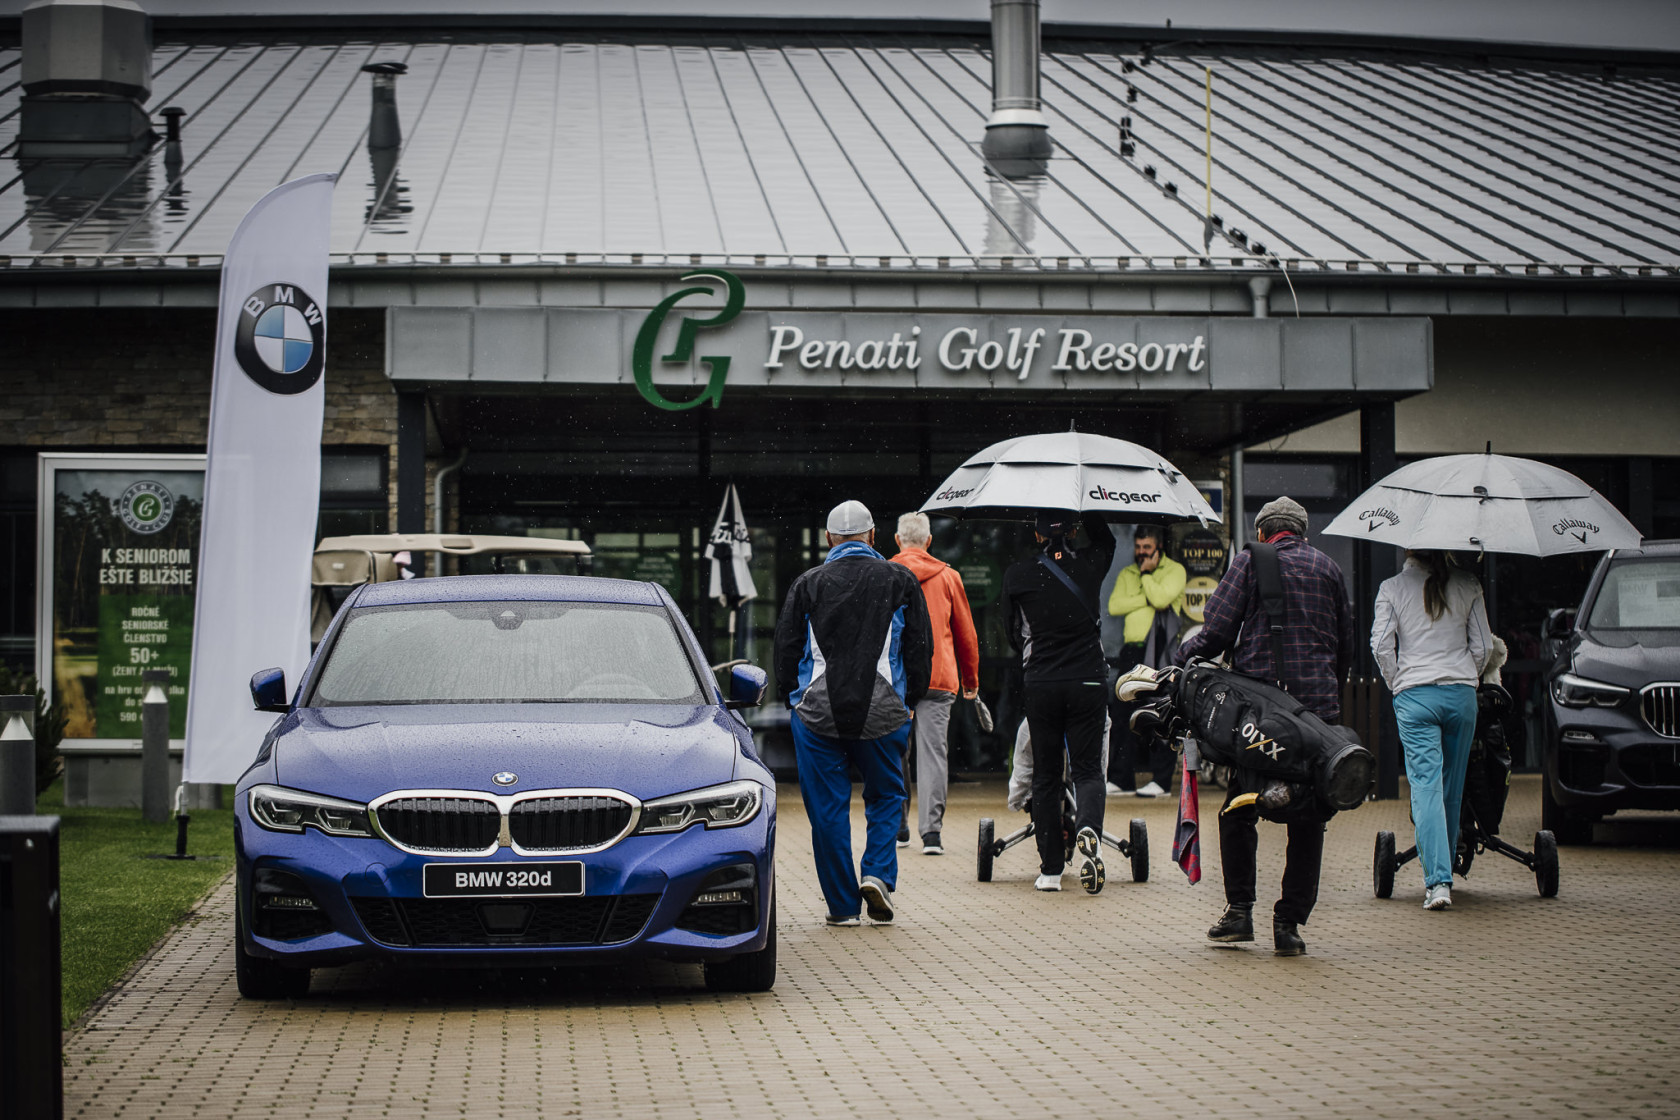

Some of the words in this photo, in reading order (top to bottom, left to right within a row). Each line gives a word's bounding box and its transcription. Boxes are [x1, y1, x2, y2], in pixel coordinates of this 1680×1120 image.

[243, 285, 322, 326] BMW
[763, 325, 922, 370] Penati
[938, 326, 1046, 380] Golf
[1051, 328, 1206, 372] Resort
[1089, 485, 1162, 504] clicgear
[1359, 507, 1400, 527] Callaway
[1552, 517, 1600, 536] Callaway
[101, 548, 112, 564] K
[116, 548, 191, 564] SENIOROM
[1183, 548, 1205, 558] TOP
[1207, 548, 1223, 558] 100
[99, 565, 134, 584] EŠTE
[139, 566, 193, 585] BLIŽŠIE
[131, 605, 160, 617] ROČNÉ
[122, 618, 169, 630] SENIORSKÉ
[123, 631, 168, 643] ČLENSTVO
[130, 647, 159, 664] 50+
[120, 711, 137, 722] 590
[455, 872, 503, 888] BMW
[506, 870, 552, 887] 320d
